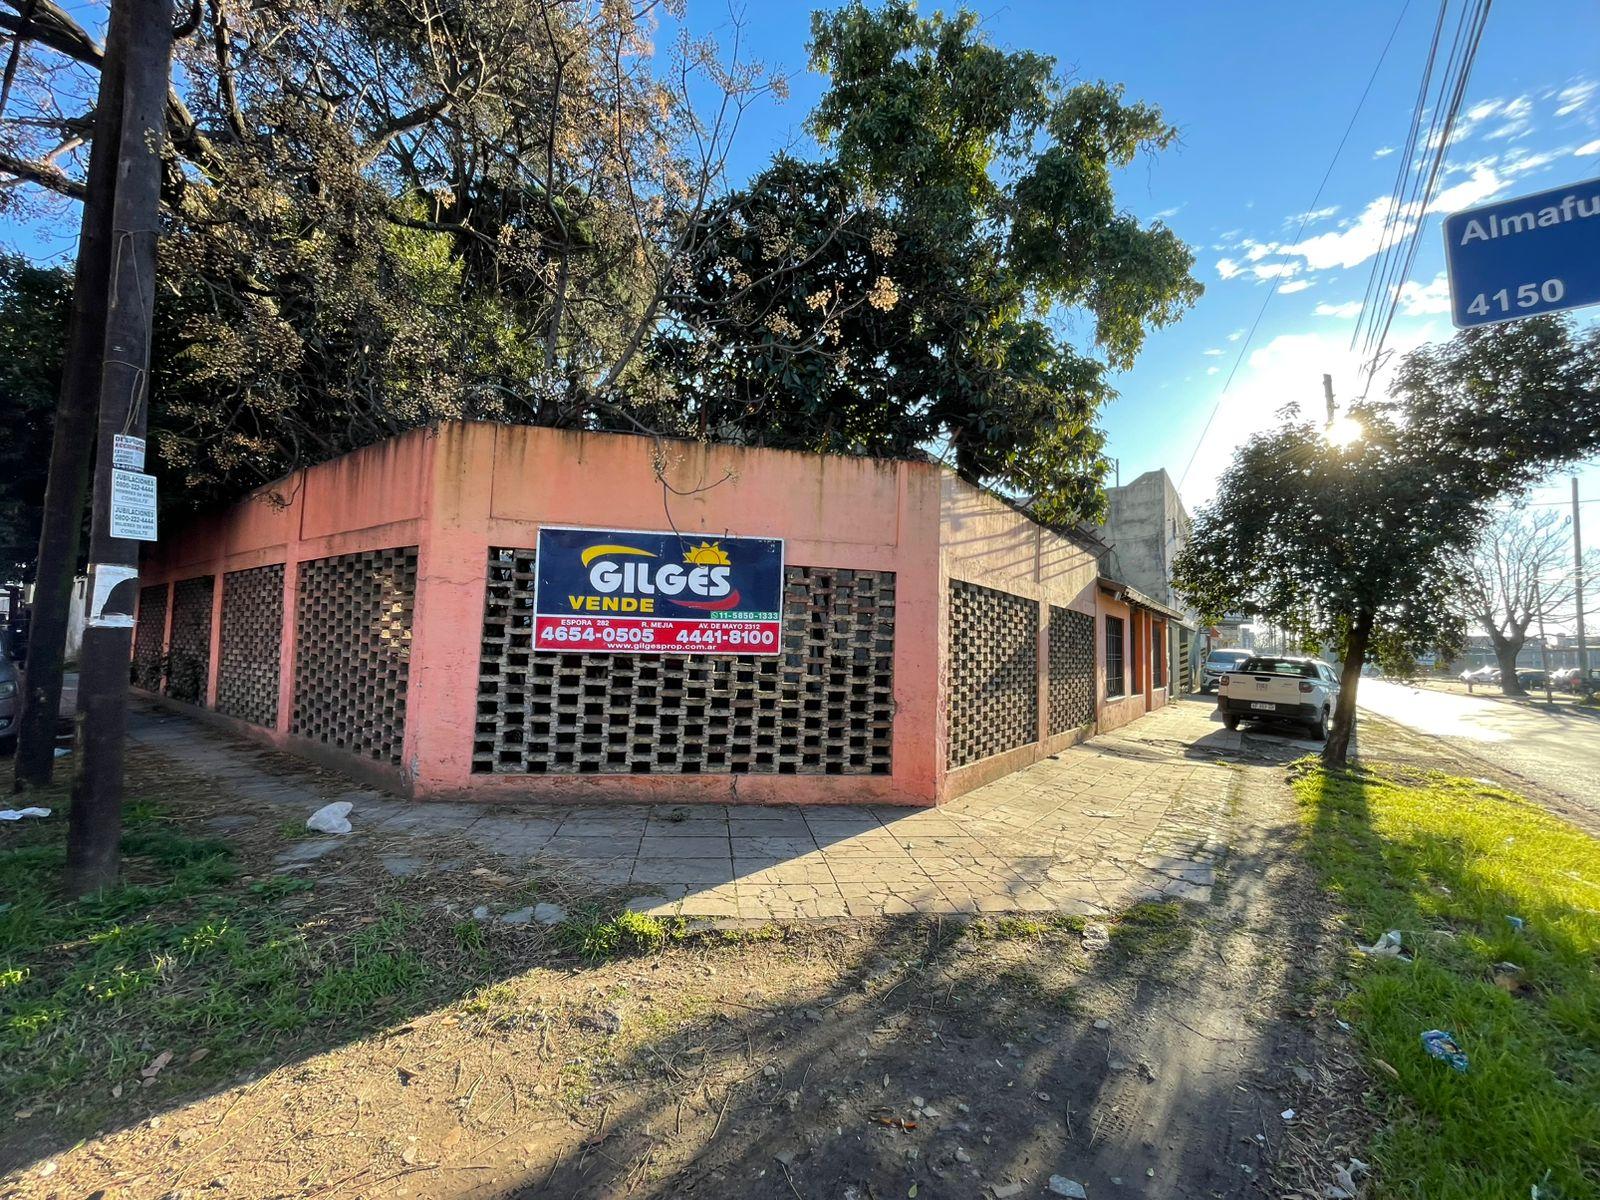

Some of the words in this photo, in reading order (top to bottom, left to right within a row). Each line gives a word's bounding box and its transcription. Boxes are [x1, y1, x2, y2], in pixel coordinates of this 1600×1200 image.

[1460, 195, 1600, 246] Almafu
[1466, 278, 1565, 316] 4150
[589, 560, 732, 597] GILGES
[568, 595, 655, 613] VENDE
[719, 612, 778, 620] 11-5850-1333
[541, 626, 655, 643] 4654-0505
[676, 629, 774, 645] 4441-8100
[607, 642, 717, 650] www.gilgesprop.com.ar
